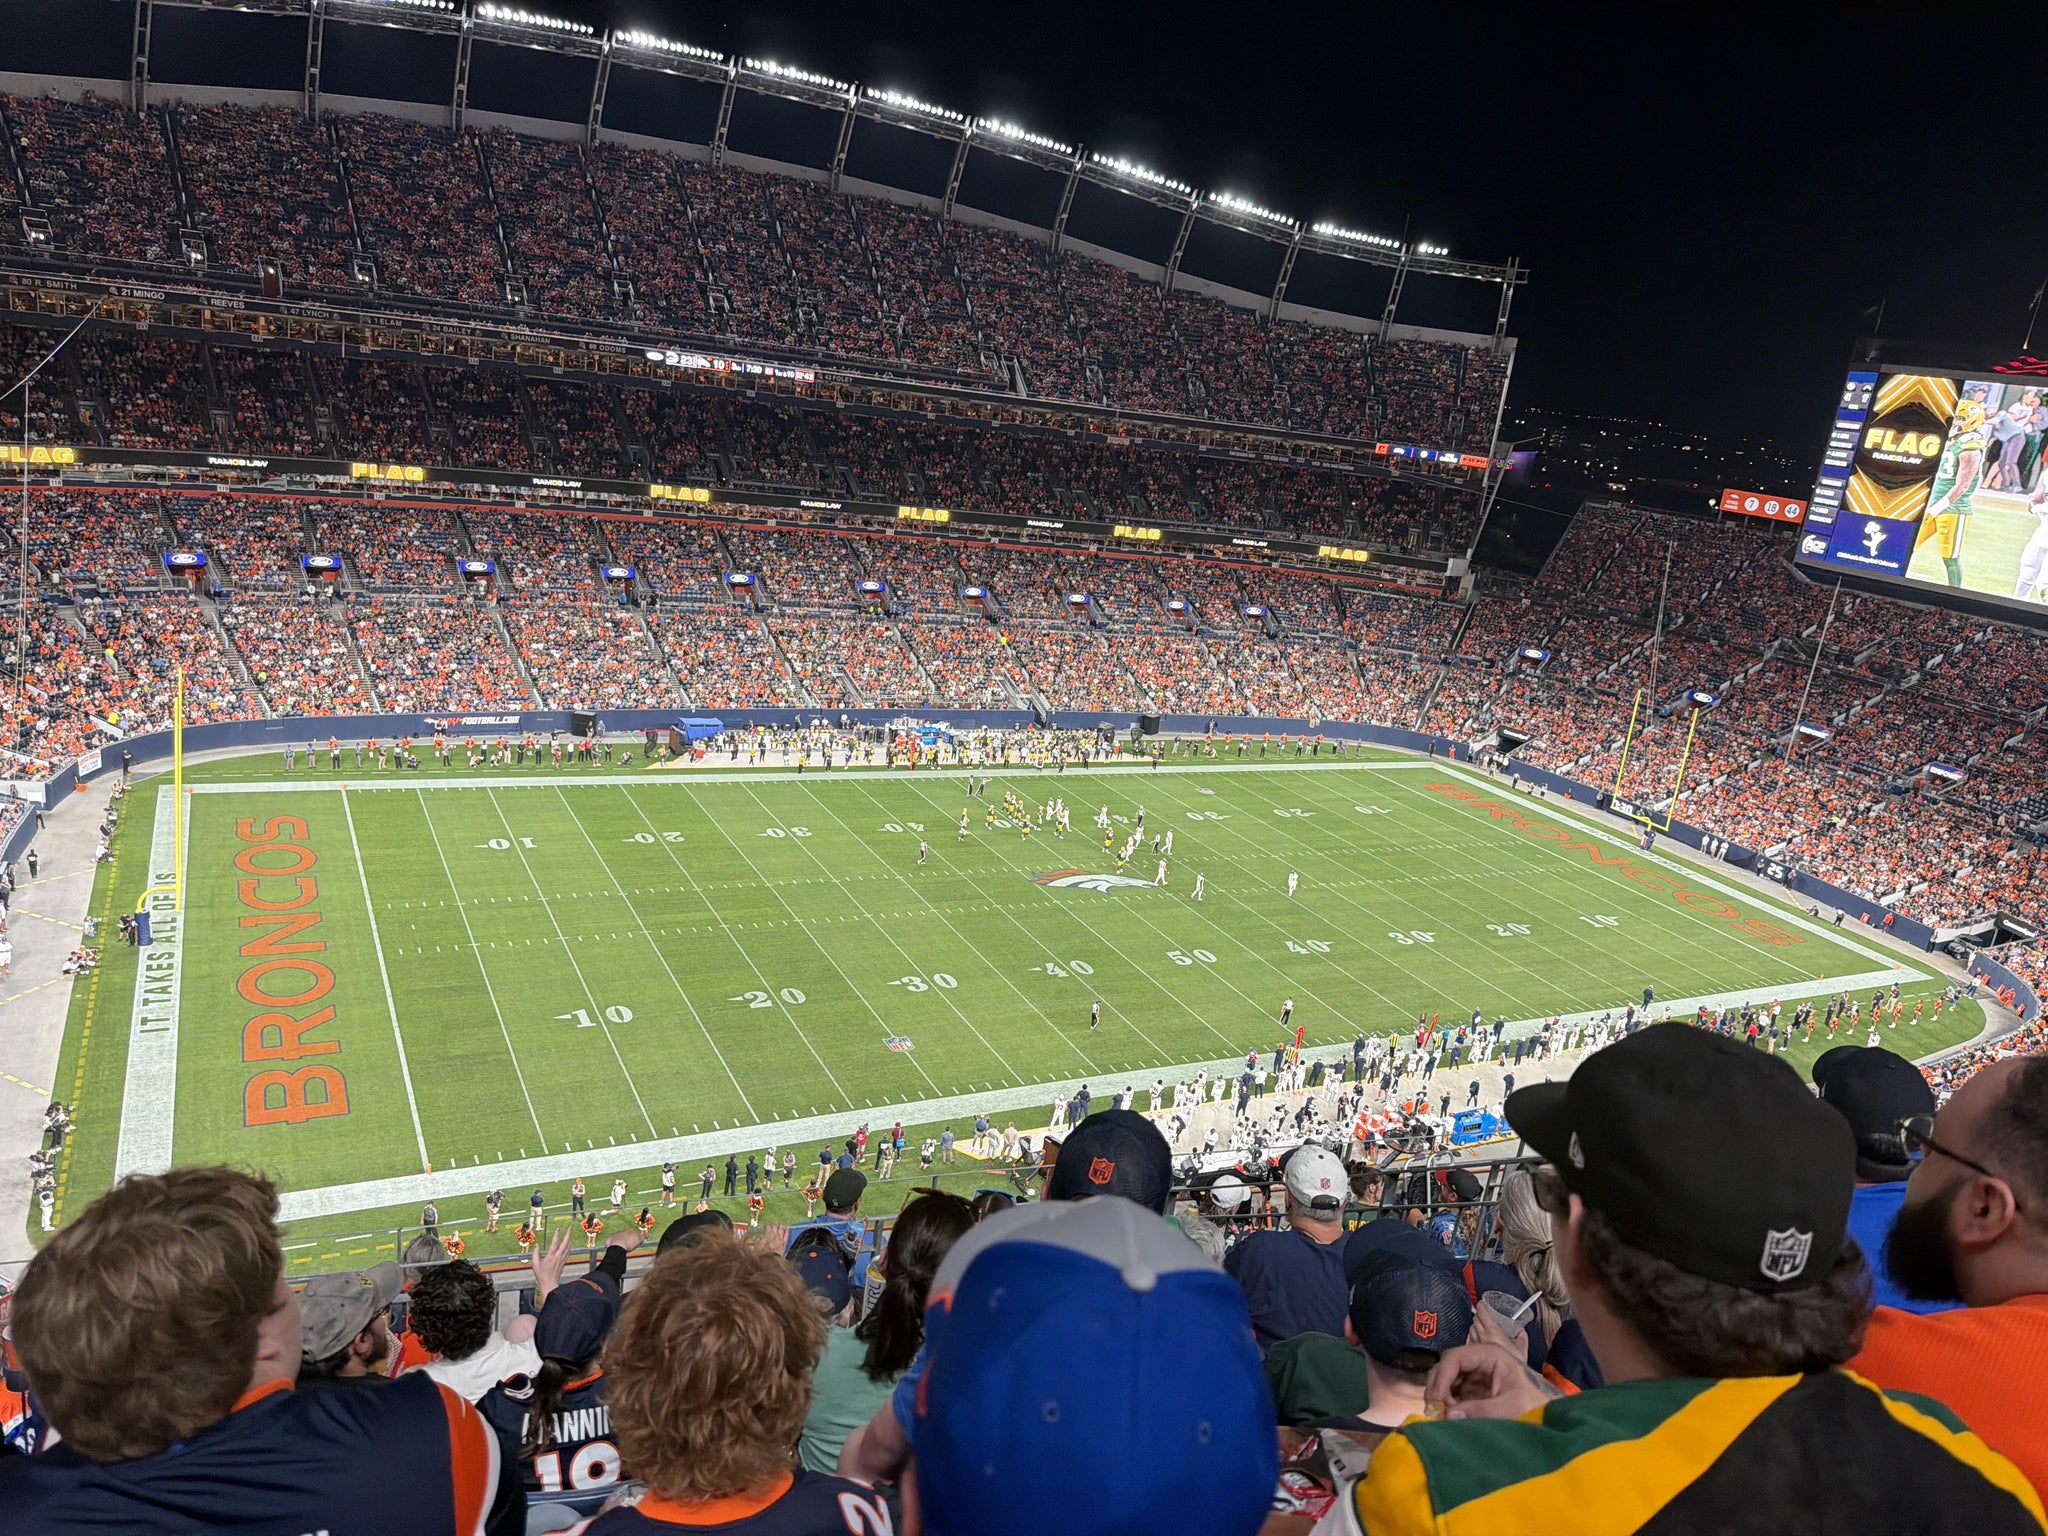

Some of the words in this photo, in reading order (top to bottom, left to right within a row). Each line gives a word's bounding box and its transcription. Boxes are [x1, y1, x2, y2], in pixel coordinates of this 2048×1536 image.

[46, 280, 78, 290] SMITH
[121, 288, 131, 296] 21
[133, 290, 165, 300] MINGO
[211, 299, 245, 309] REEVES
[290, 307, 299, 315] 47
[302, 309, 329, 318] LYNCH
[379, 318, 402, 327] ELAM
[443, 326, 471, 335] BAILEY
[510, 333, 550, 344] SHANAHAN
[599, 345, 626, 354] ODOMS
[713, 359, 725, 370] 10
[832, 375, 854, 383] FOLEY
[1864, 428, 1941, 457] FLAG
[208, 457, 245, 466] RAMOS
[247, 459, 269, 468] LAW
[1872, 452, 1902, 461] RAMOS
[1903, 456, 1922, 464] LAW
[352, 462, 424, 482] FLAG
[532, 478, 563, 487] RAMOS
[564, 480, 582, 488] LAW
[650, 484, 710, 502] FLAG
[800, 500, 826, 509] RAMOS
[898, 506, 949, 522] FLAG
[1027, 520, 1050, 528] RAMOS
[1113, 525, 1161, 540] FLAG
[1232, 538, 1253, 546] RAMOS
[1318, 545, 1368, 562] FLAG
[488, 836, 538, 851] 10
[634, 831, 685, 845] 20
[1423, 783, 1806, 947] BRONCOS
[1767, 862, 1784, 879] 25
[152, 895, 177, 911] OF
[1579, 914, 1619, 928] 10
[151, 917, 177, 943] ALL
[1388, 929, 1435, 945] 30
[1486, 922, 1531, 937] 20
[1285, 938, 1331, 955] 40
[1165, 948, 1218, 966] 50
[234, 815, 350, 1127] BRONCOS
[1045, 959, 1095, 979] 40
[143, 952, 175, 1007] TAKES
[900, 973, 958, 992] 30
[743, 987, 807, 1009] 20
[571, 1004, 634, 1029] 10
[139, 1015, 171, 1034] IT
[1767, 1251, 1802, 1274] NFL
[1416, 1321, 1436, 1336] NFL
